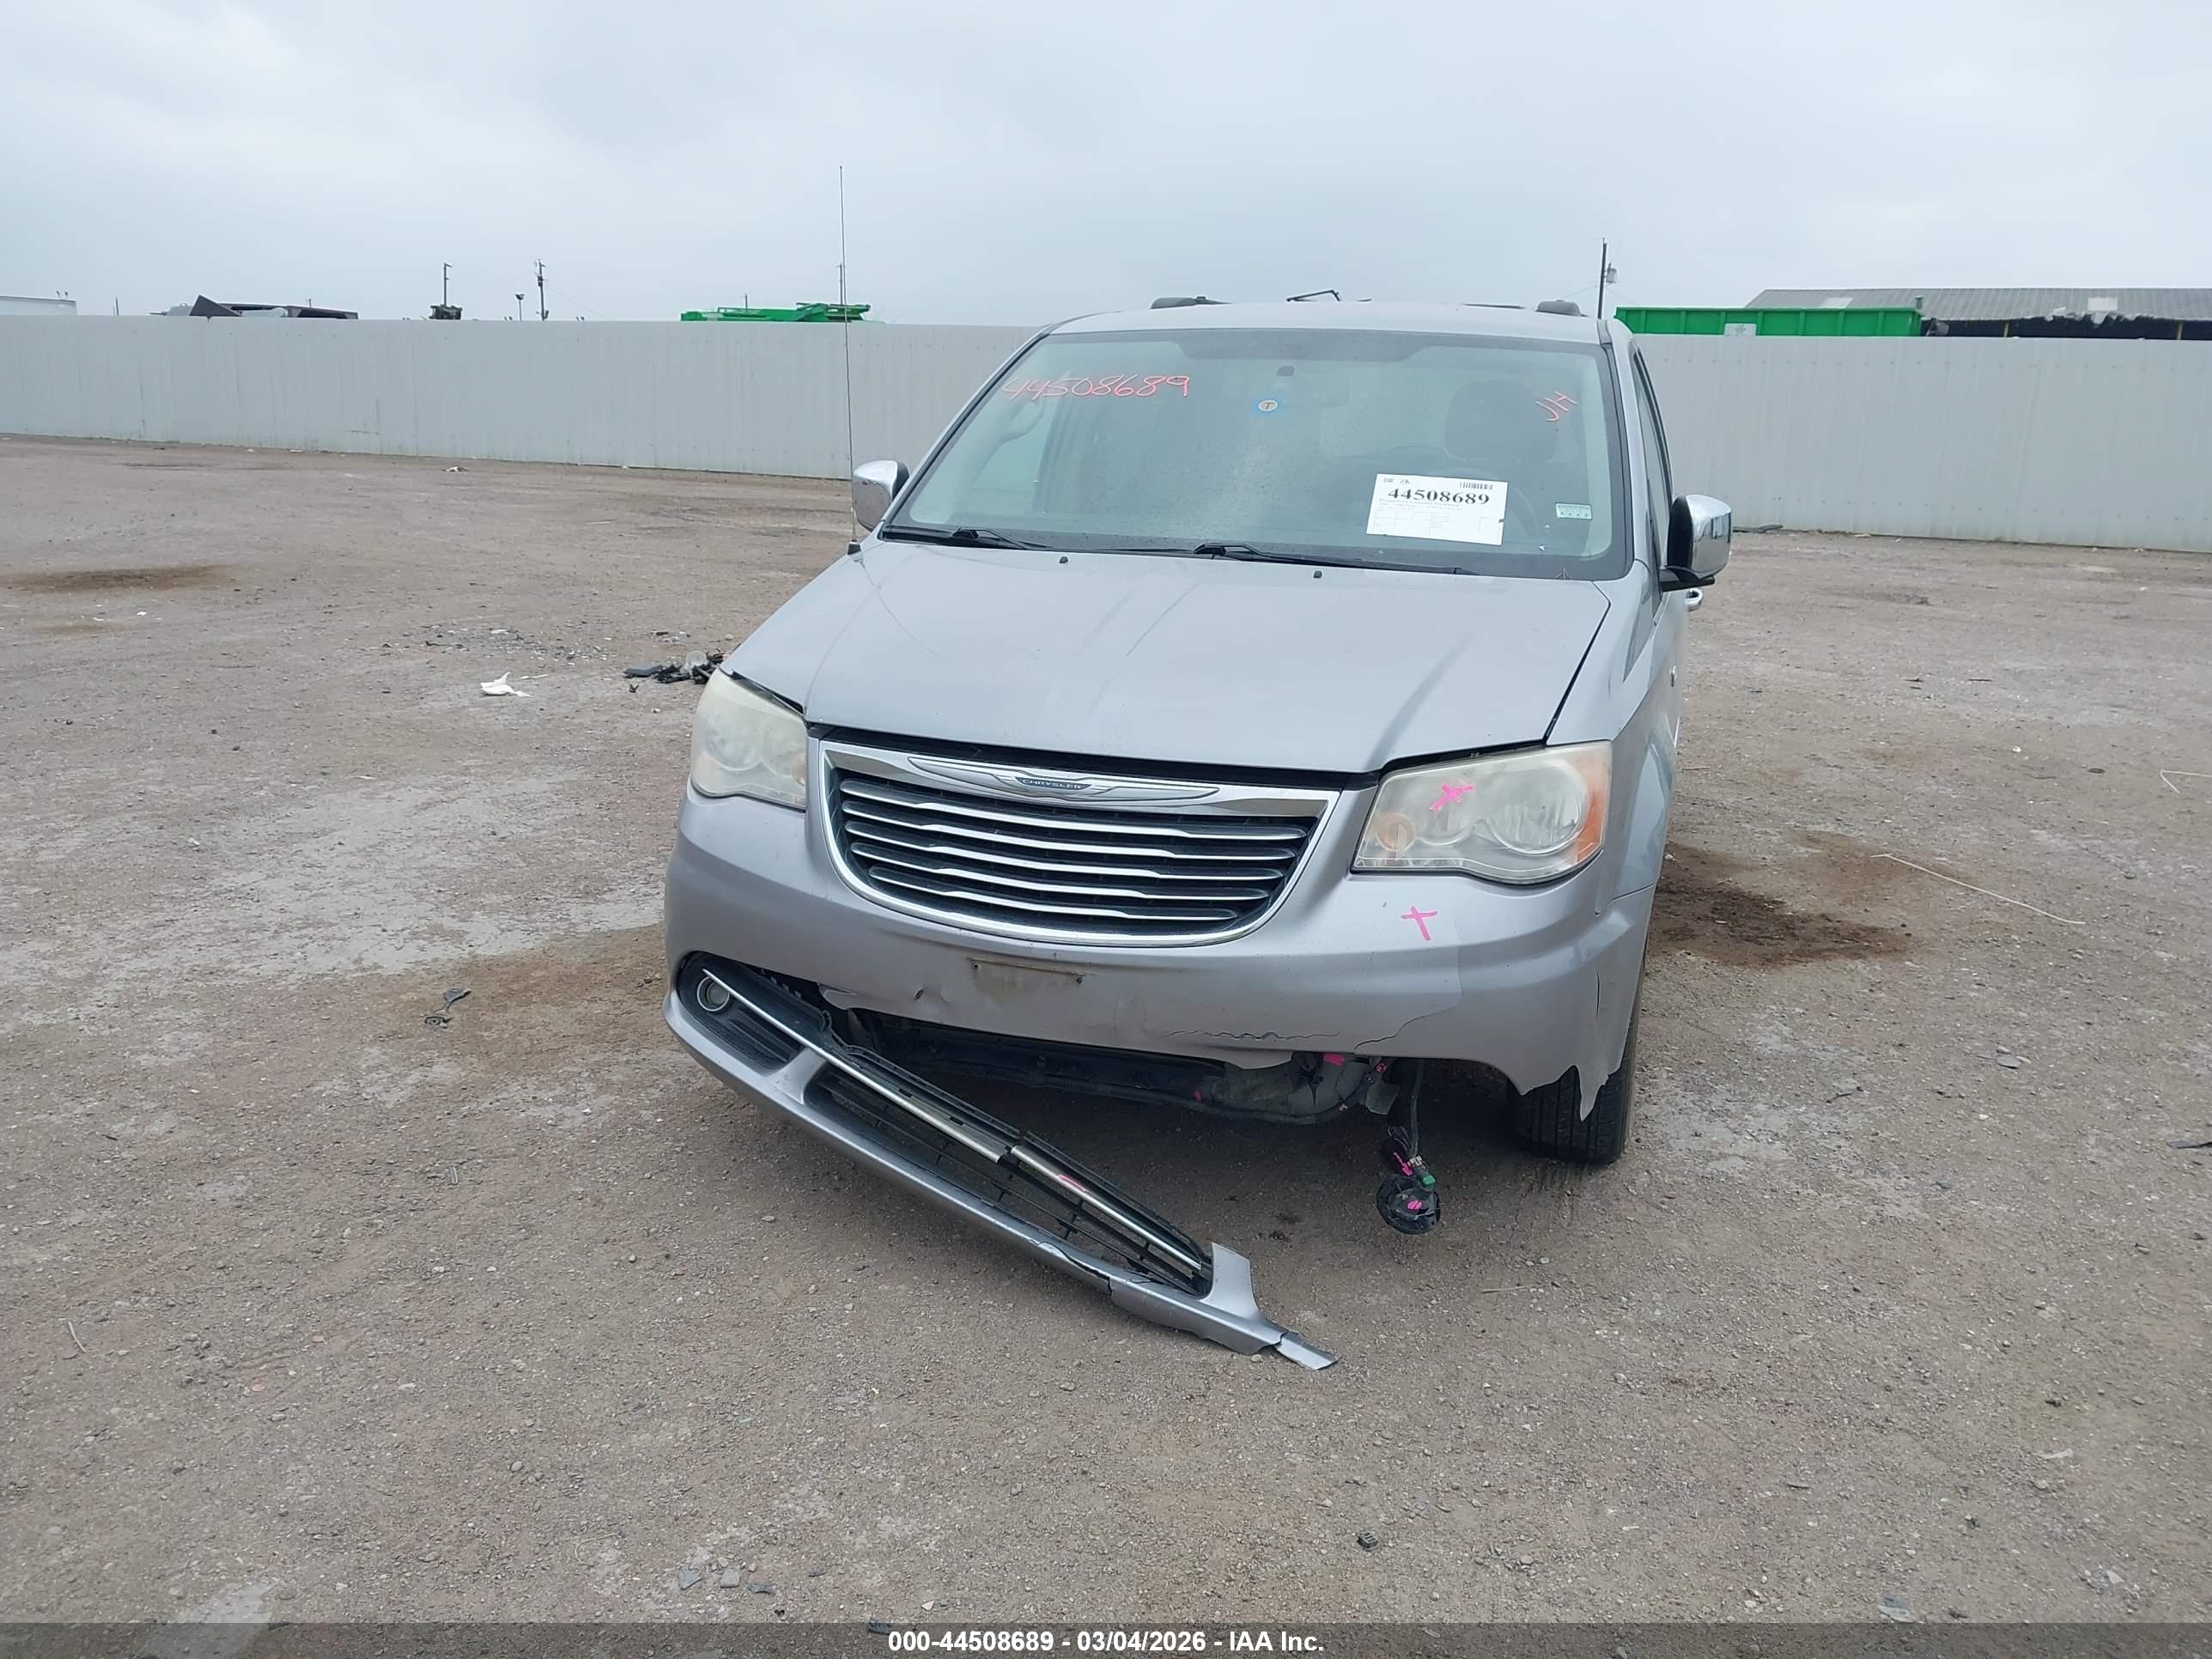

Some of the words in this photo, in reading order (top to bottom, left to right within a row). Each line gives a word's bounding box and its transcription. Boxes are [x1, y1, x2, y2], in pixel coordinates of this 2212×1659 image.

[1001, 373, 1190, 401] 44508689
[1388, 488, 1490, 506] 44508689
[1021, 778, 1083, 790] CHRYSLER
